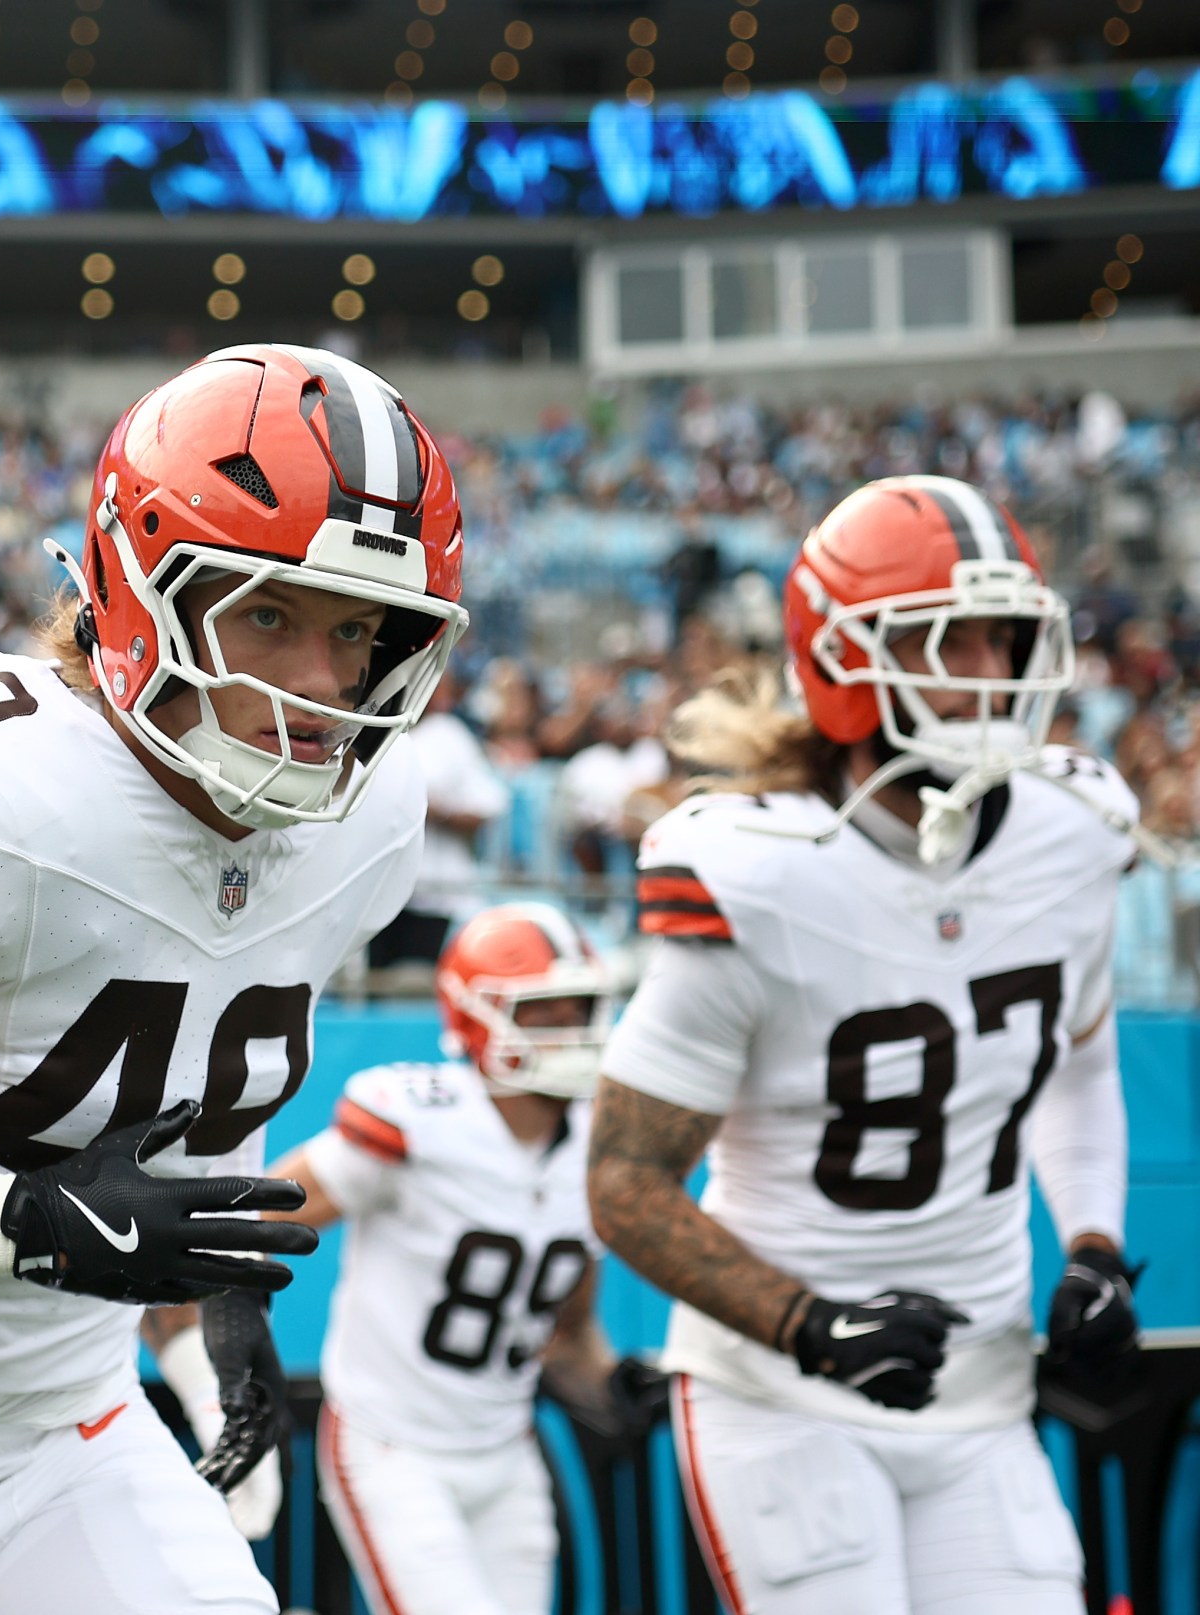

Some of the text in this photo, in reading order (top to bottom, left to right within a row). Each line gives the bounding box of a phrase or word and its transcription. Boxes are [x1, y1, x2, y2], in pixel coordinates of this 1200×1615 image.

[352, 529, 408, 557] BROWNS
[223, 886, 246, 909] NFL
[813, 961, 1062, 1211] 87
[423, 1230, 587, 1370] 89
